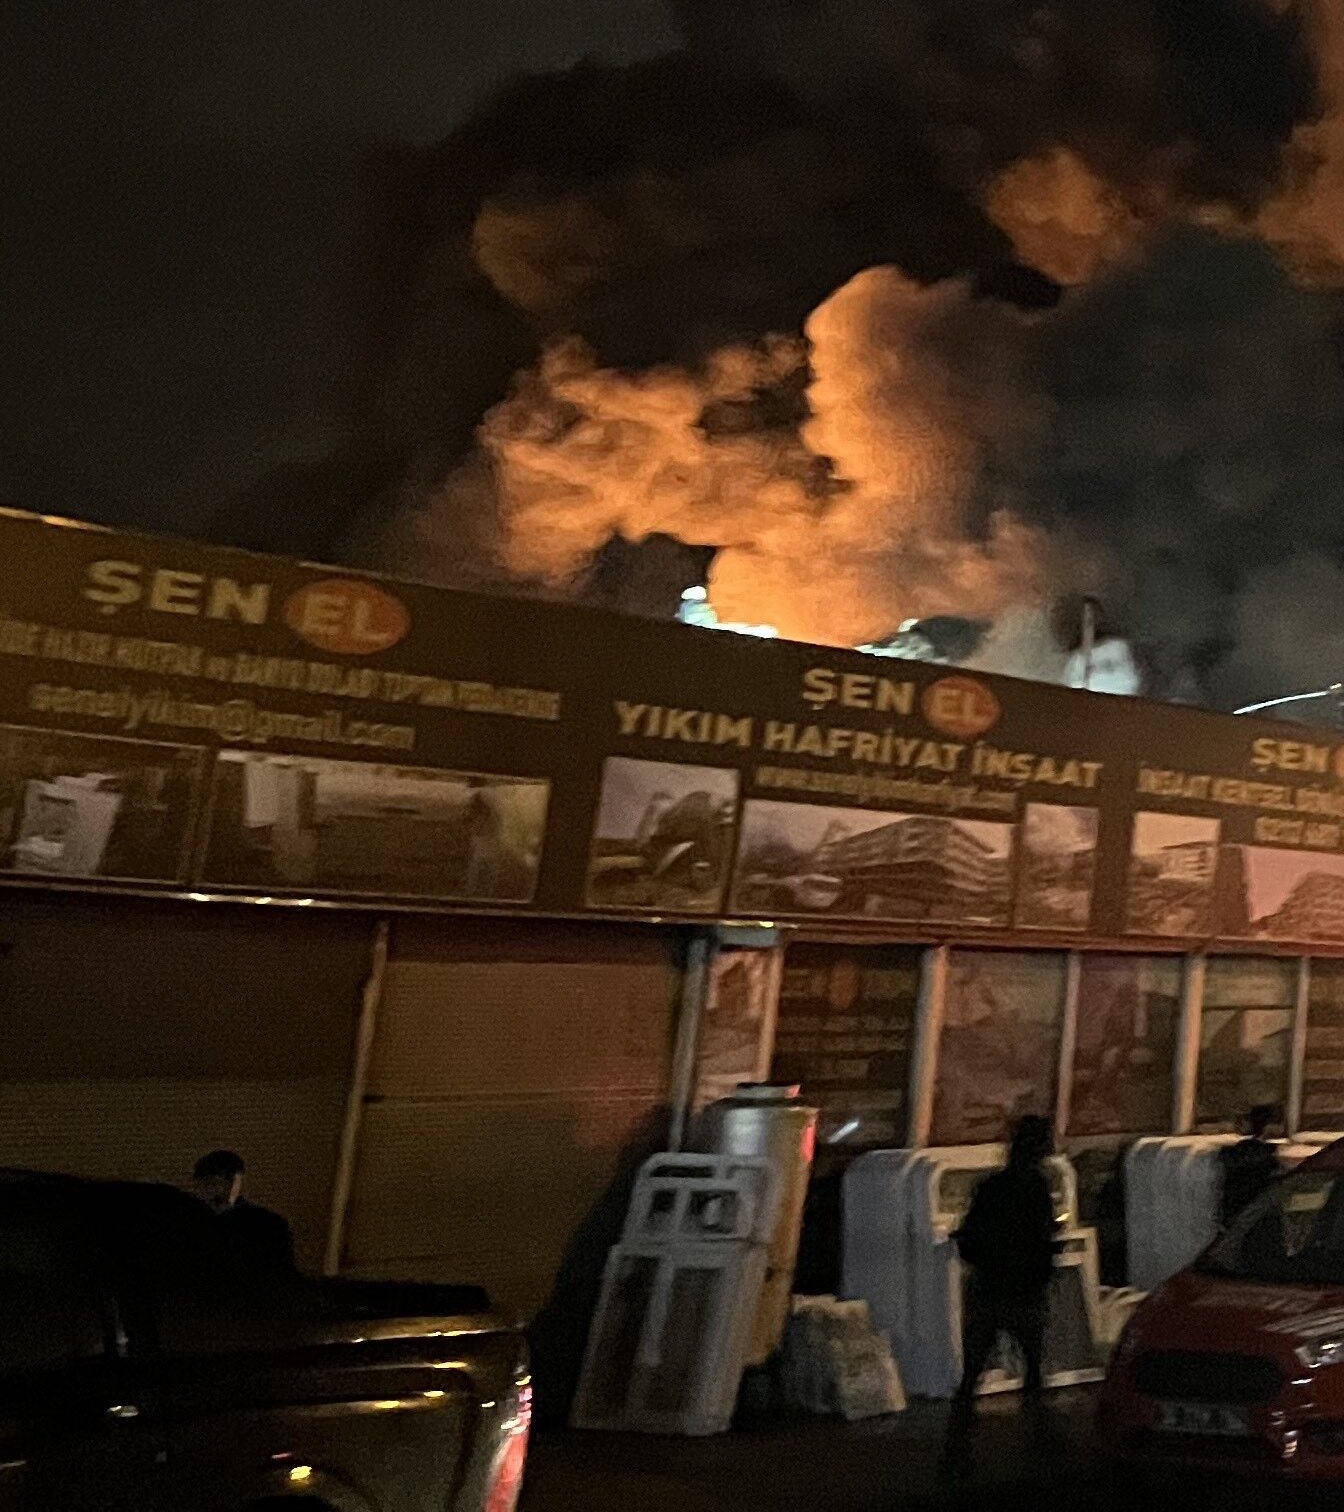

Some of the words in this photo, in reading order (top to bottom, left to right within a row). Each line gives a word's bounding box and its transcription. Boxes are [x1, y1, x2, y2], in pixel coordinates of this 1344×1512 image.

[84, 561, 273, 624] ŞEN
[303, 592, 390, 643] EL
[803, 668, 917, 715] ŞEN
[932, 689, 985, 722] EL
[614, 701, 753, 747] YIKIM
[763, 720, 966, 772] HAFRİYAT
[972, 740, 1104, 788] İNŞAAT
[1252, 738, 1330, 773] ŞEN
